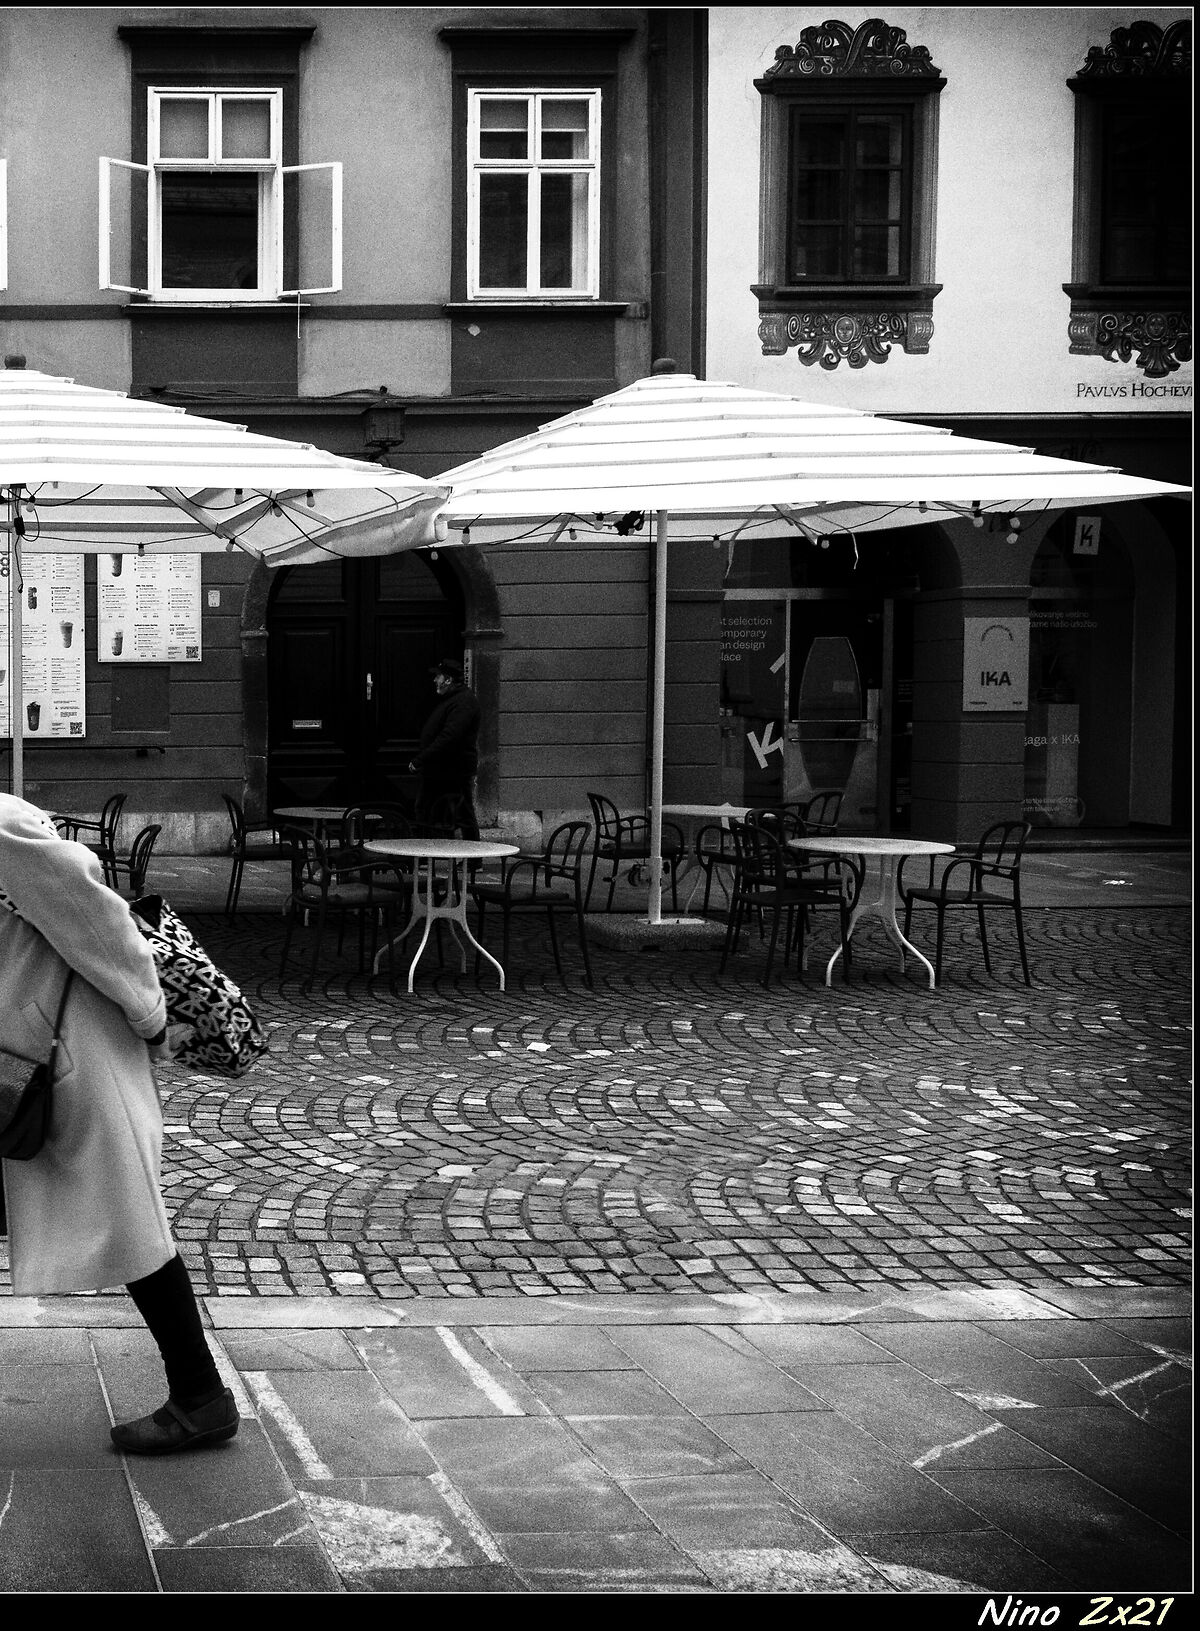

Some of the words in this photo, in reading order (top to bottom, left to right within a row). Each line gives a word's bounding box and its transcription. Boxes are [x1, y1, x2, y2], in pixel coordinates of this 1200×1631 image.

[728, 616, 773, 626] selection
[732, 640, 766, 651] design
[981, 671, 1012, 686] IKA
[1062, 734, 1081, 744] IKA
